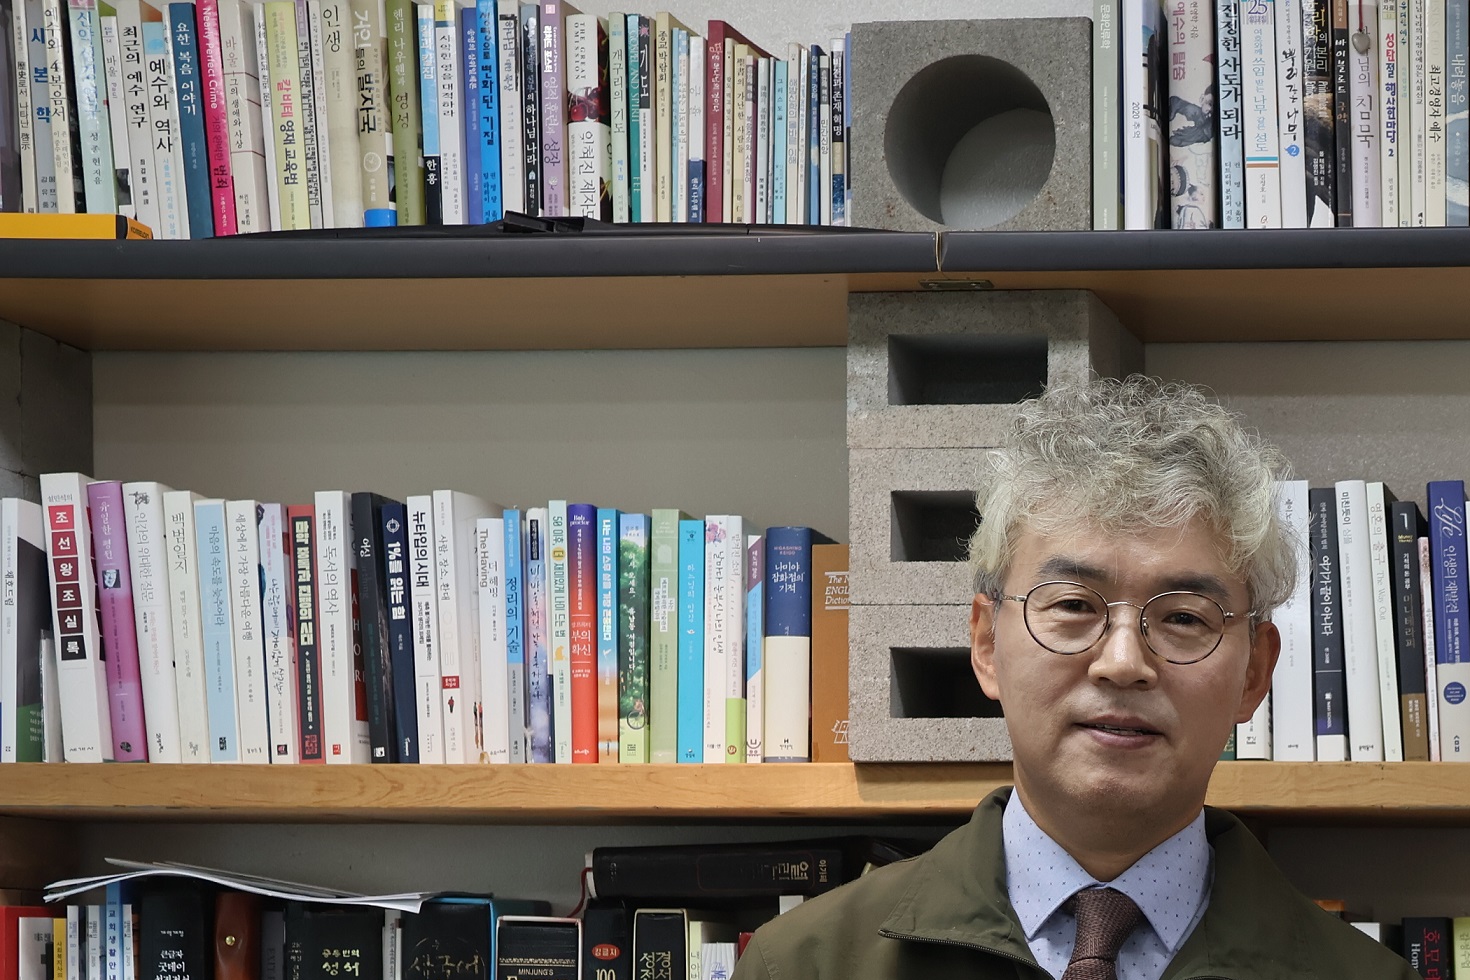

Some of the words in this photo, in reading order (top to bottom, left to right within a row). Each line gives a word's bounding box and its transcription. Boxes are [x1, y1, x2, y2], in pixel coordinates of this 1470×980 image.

[176, 23, 191, 45] 요한
[202, 9, 211, 37] Nearly
[322, 8, 341, 53] 인생
[1220, 4, 1240, 51] 진정한
[177, 51, 193, 75] 복음
[205, 38, 215, 74] Perfect
[148, 57, 167, 109] 예수와
[208, 79, 218, 109] Crime
[1220, 57, 1241, 102] 사도가
[180, 80, 196, 115] 이야기
[155, 119, 173, 152] 역사
[1220, 108, 1241, 141] 되라
[479, 529, 489, 547] The
[479, 550, 489, 588] Having
[772, 573, 804, 584] 잡화점의
[775, 563, 800, 573] 나미야
[506, 577, 520, 620] 정리의
[779, 584, 796, 593] 기적
[506, 627, 520, 653] 기술
[158, 962, 186, 972] 굿데이
